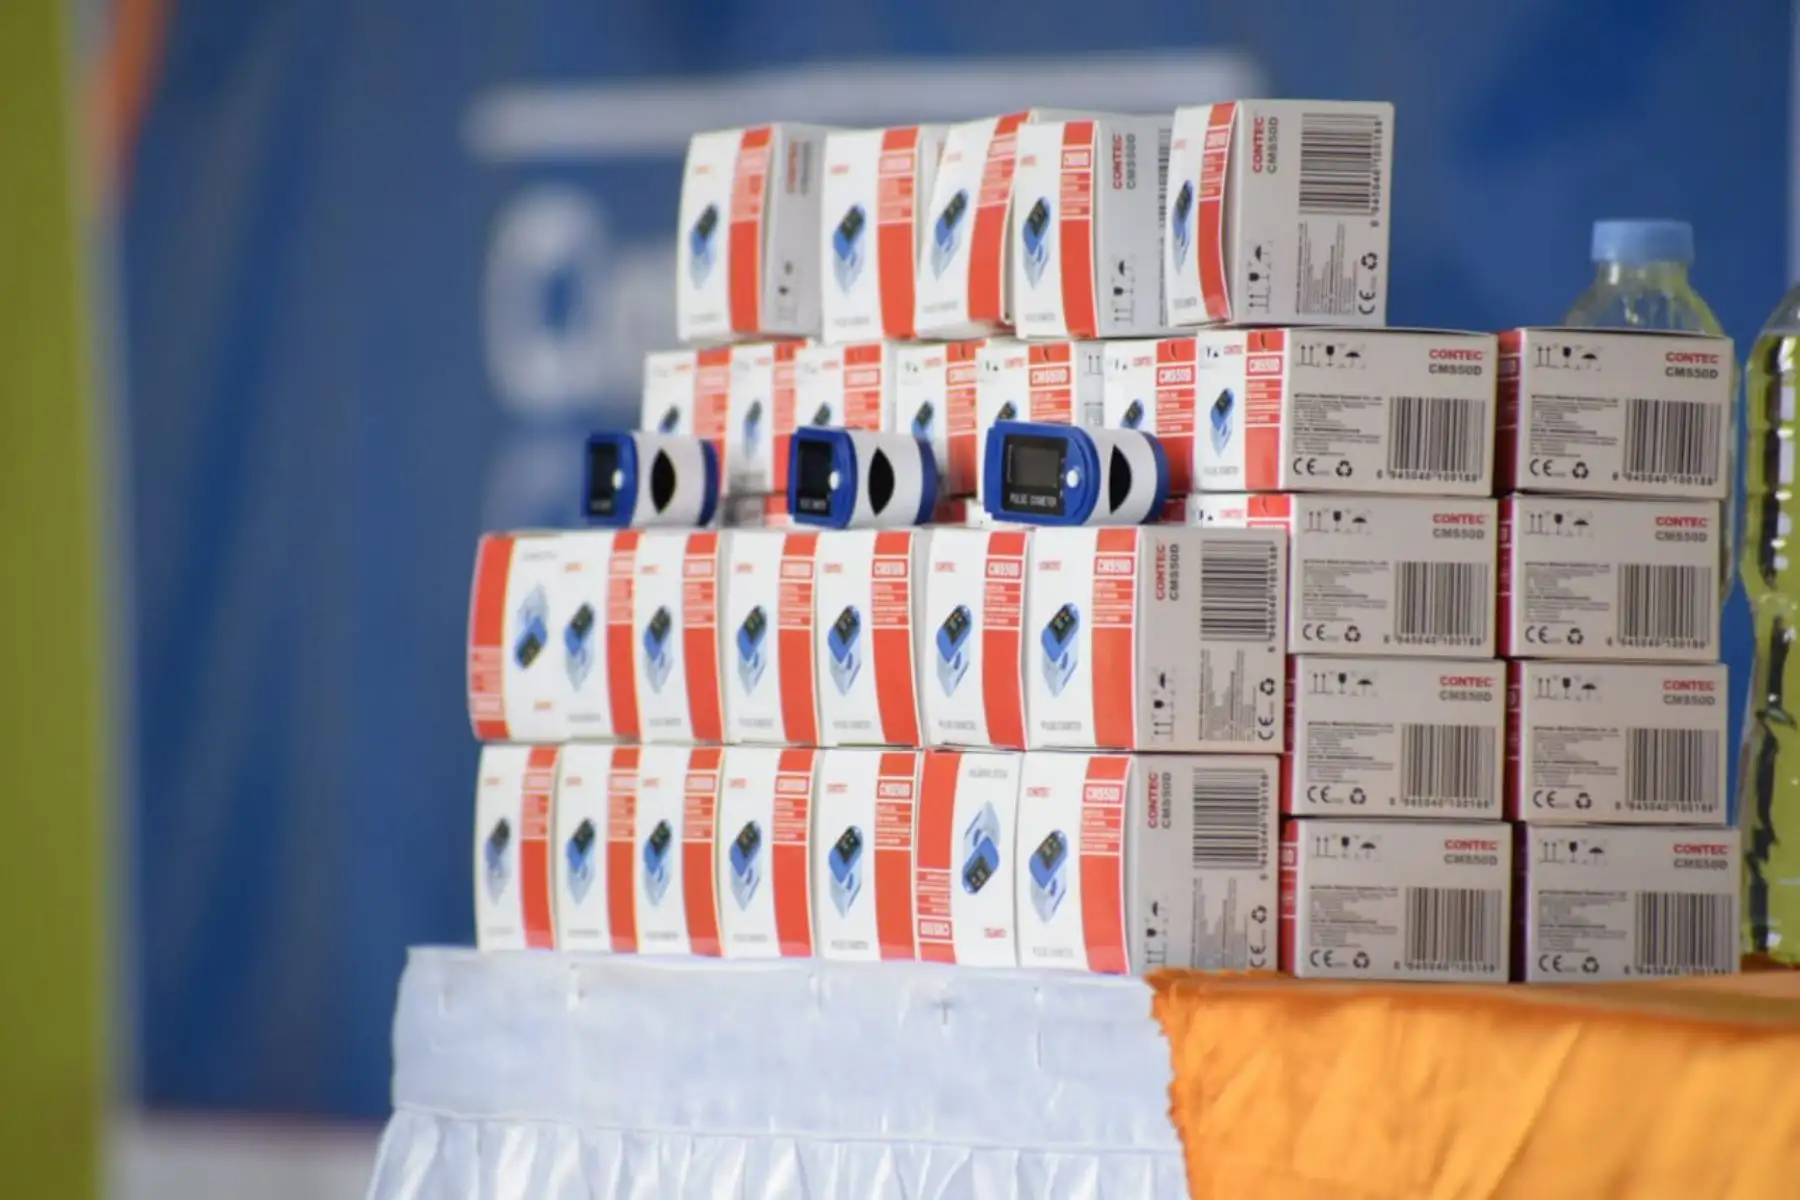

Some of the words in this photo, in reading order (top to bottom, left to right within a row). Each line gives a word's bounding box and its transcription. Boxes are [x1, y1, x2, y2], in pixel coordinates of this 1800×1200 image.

[1253, 116, 1265, 174] CONTEC
[1267, 116, 1279, 174] CMS50D
[1113, 133, 1123, 190] CONTEC
[1429, 349, 1484, 361] CONTEC
[1665, 352, 1720, 364] CONTEC
[1428, 363, 1483, 376] CMS50D
[1665, 367, 1719, 380] CMS50D
[1432, 513, 1486, 524] CONTEC
[1655, 516, 1708, 528] CONTEC
[1432, 528, 1485, 539] CMS50D
[1655, 530, 1708, 542] CMS50D
[1155, 543, 1166, 601] CONTEC
[1169, 543, 1180, 601] CMS50D
[1439, 676, 1493, 688] CONTEC
[1663, 680, 1716, 692] CONTEC
[1439, 690, 1493, 702] CMS50D
[1663, 694, 1716, 706] CMS50D
[1148, 772, 1159, 830] CONTEC
[1161, 772, 1172, 830] CMS50D
[1444, 839, 1498, 851] CONTEC
[1673, 844, 1729, 855] CONTEC
[1443, 854, 1498, 866] CMS50D
[1673, 858, 1728, 870] CMS50D
